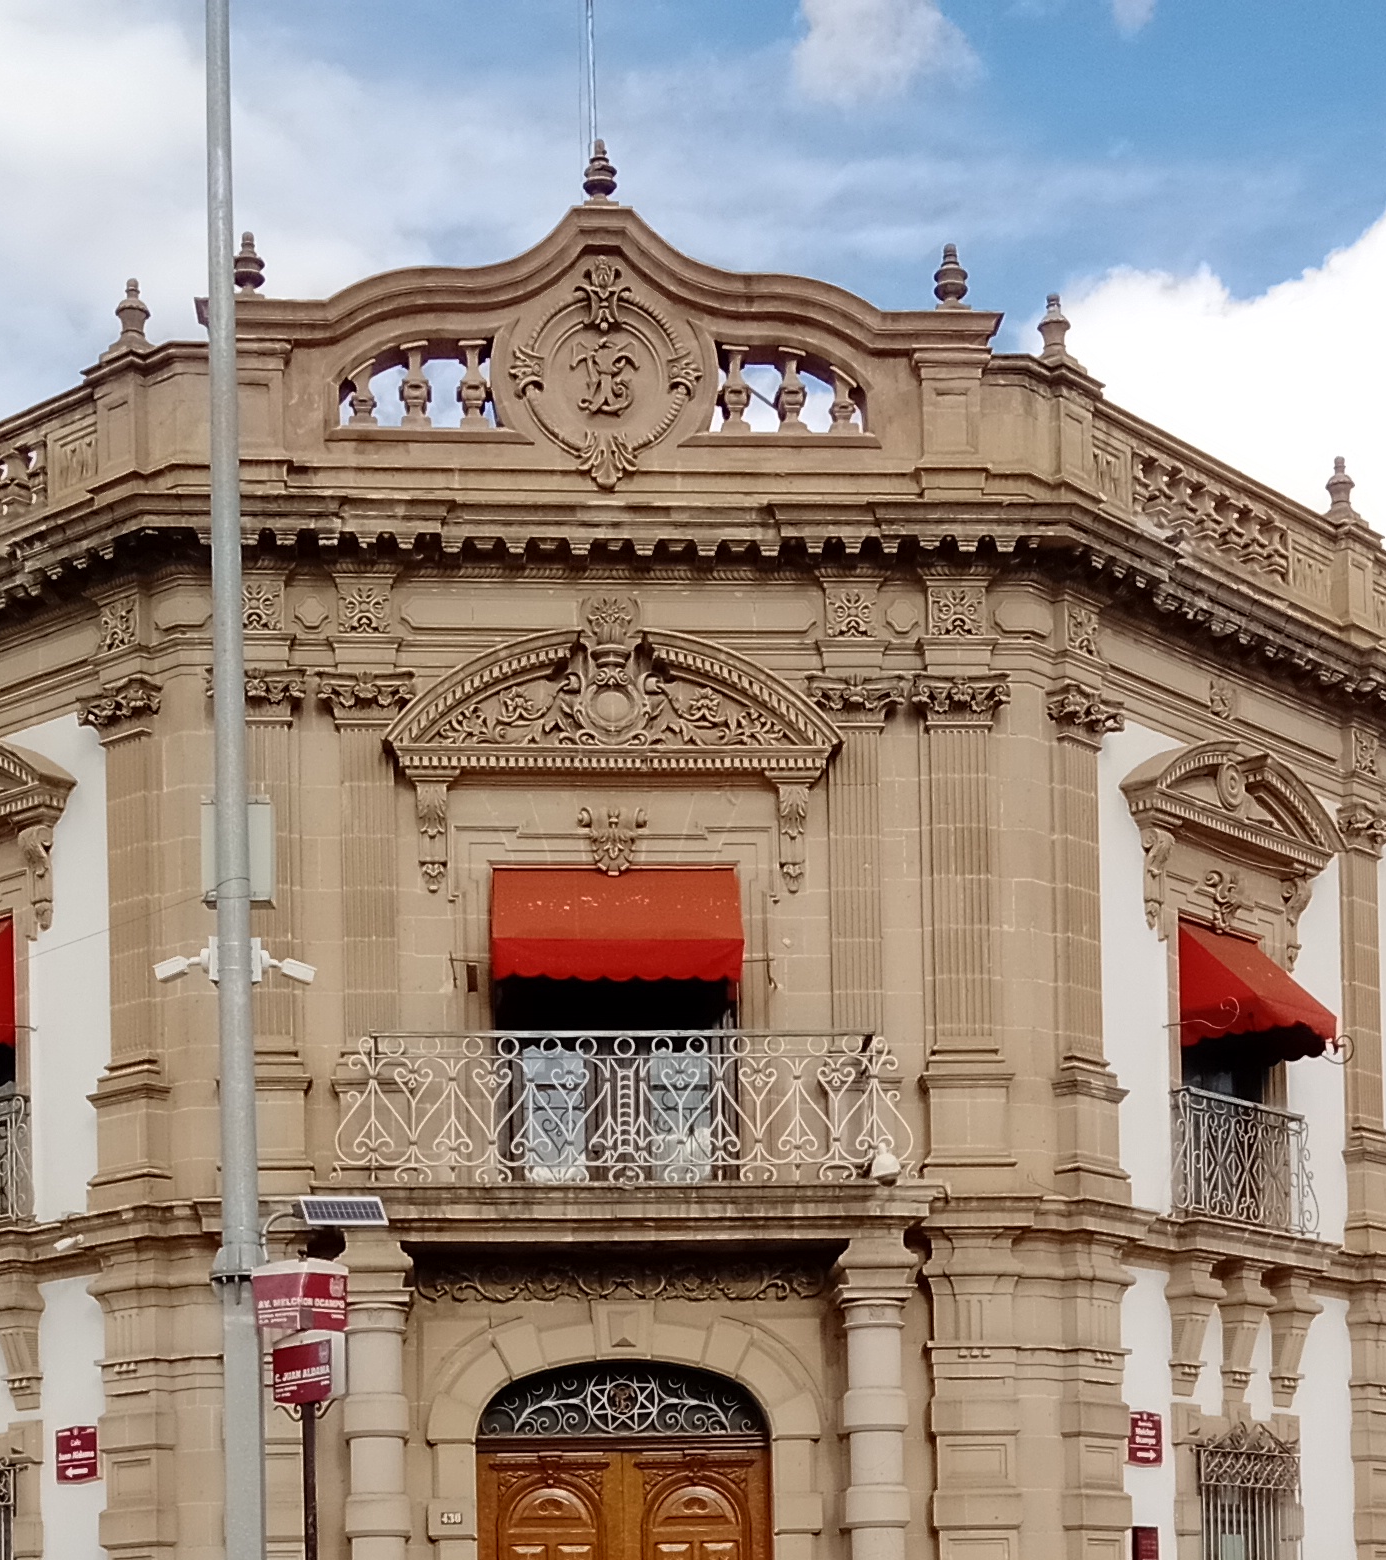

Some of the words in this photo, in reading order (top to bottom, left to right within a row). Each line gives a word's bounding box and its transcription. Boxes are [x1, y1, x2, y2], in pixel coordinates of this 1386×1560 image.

[314, 1297, 345, 1309] OCAMPO
[282, 1369, 301, 1382] JUAN
[302, 1364, 330, 1378] ALDAMA
